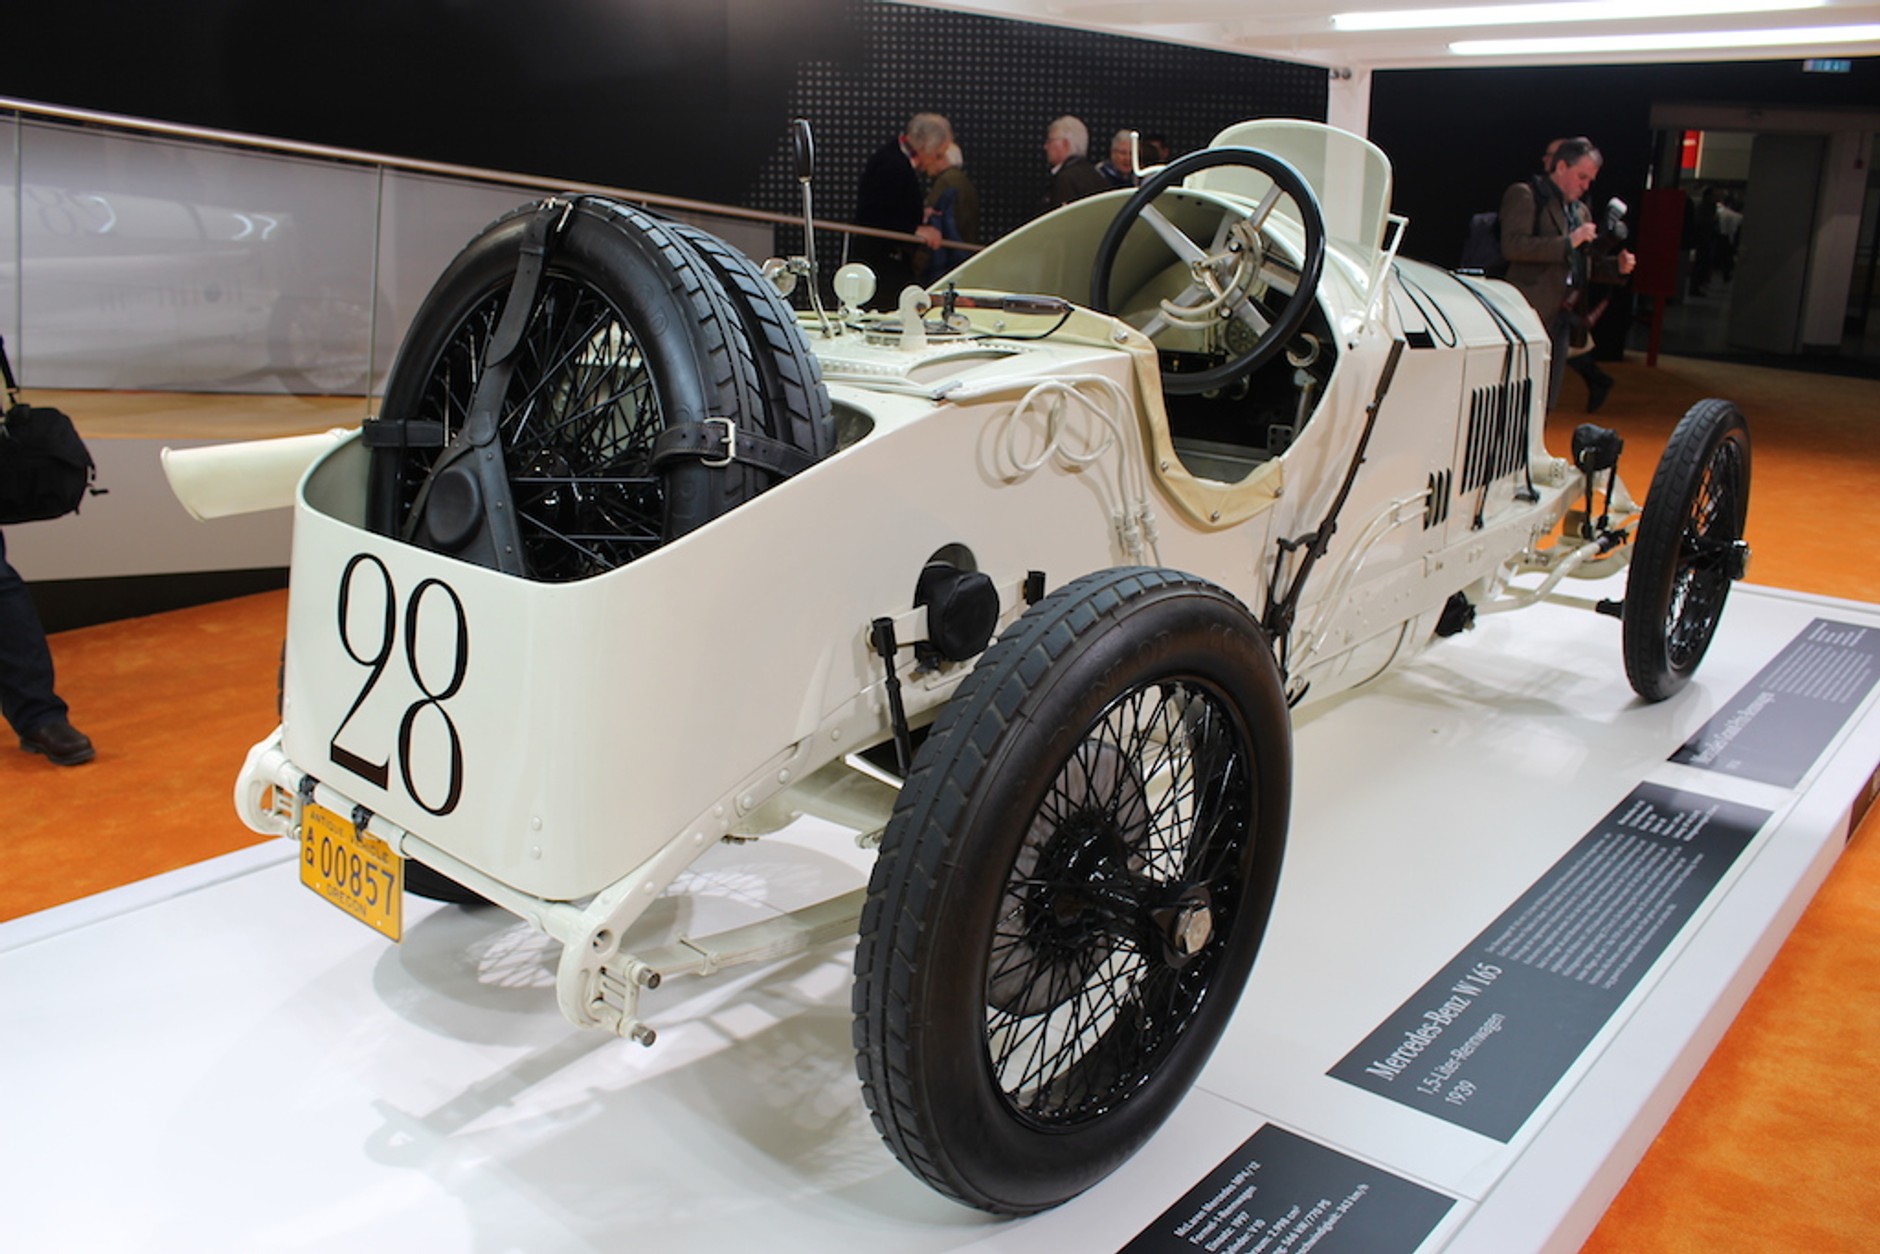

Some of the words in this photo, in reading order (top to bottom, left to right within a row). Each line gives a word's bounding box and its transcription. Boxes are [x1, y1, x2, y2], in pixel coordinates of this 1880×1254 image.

[330, 552, 469, 817] 28
[321, 836, 395, 916] 00857
[326, 883, 367, 917] OREGON
[1452, 980, 1483, 997] W
[1466, 962, 1503, 986] 165
[1365, 995, 1472, 1081] Mercedes-Benz
[1416, 1012, 1506, 1095] 1,5-Liter-Rennwagen
[1445, 1079, 1477, 1106] 1939
